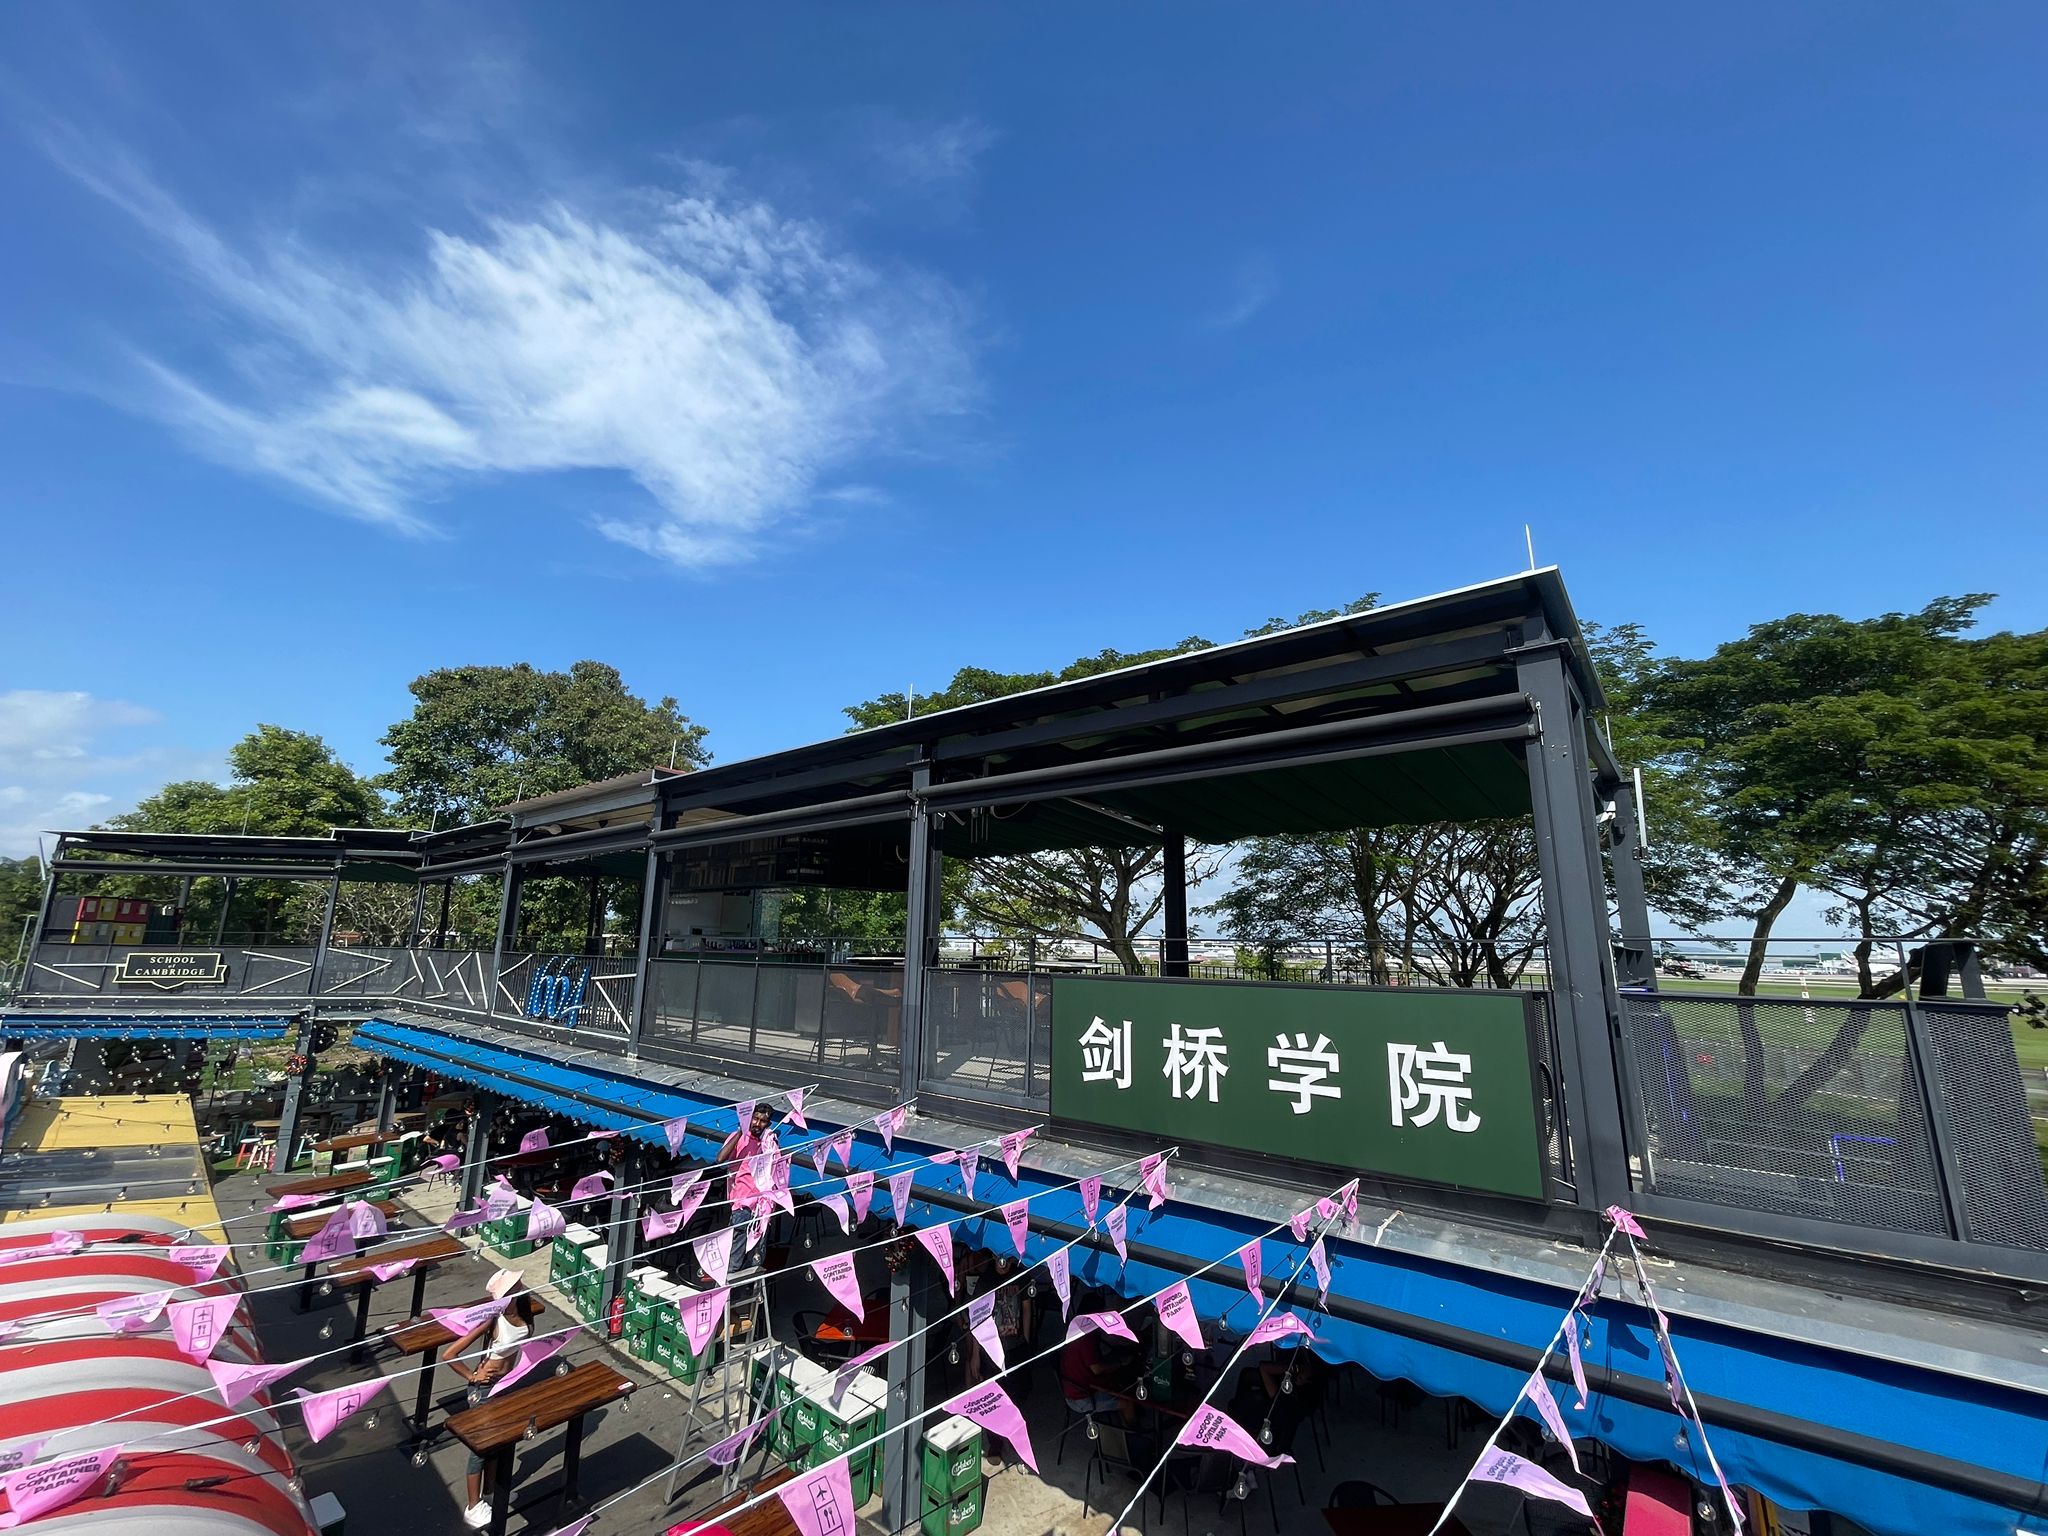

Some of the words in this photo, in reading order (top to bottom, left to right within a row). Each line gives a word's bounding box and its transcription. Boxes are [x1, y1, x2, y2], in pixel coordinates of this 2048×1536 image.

[149, 956, 196, 964] SCHOOL
[135, 968, 206, 976] CAMBRIDGE
[1079, 1015, 1482, 1133] 剑桥学院
[822, 1266, 853, 1279] CONTAINER
[823, 1261, 849, 1273] COSFORD
[963, 1392, 995, 1409] COSFORD
[965, 1393, 1004, 1414] CONTAINER
[1196, 1412, 1214, 1439] COSFORD
[1202, 1415, 1224, 1444] CONTAINER
[15, 1463, 102, 1491] CONTAINER
[25, 1456, 99, 1481] COSFORD
